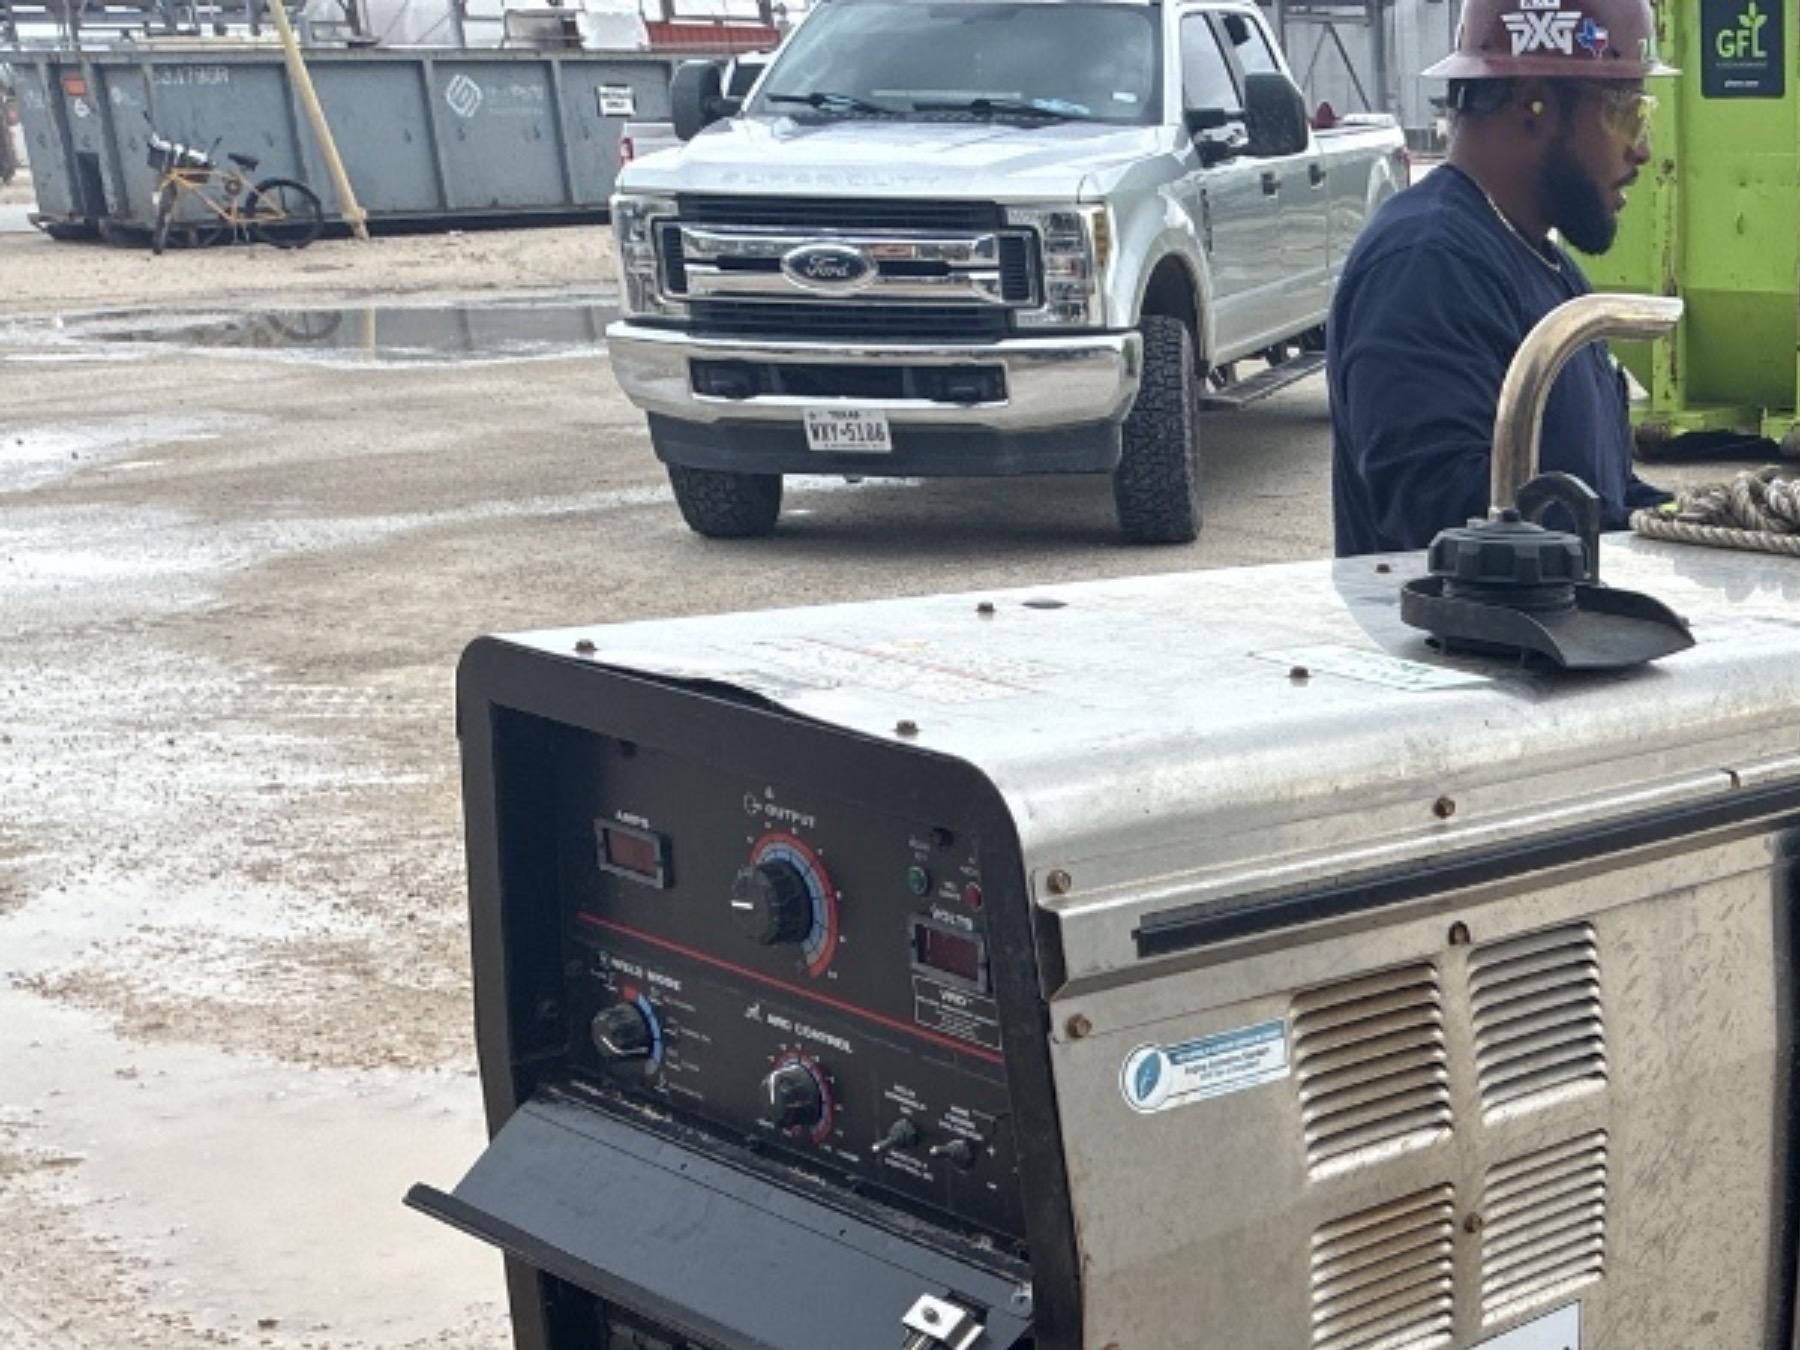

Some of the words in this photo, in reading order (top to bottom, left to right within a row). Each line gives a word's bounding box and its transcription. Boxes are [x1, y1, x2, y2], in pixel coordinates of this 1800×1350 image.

[1715, 28, 1768, 58] GFL
[805, 254, 850, 278] Ford
[764, 804, 815, 829] OUTPUT
